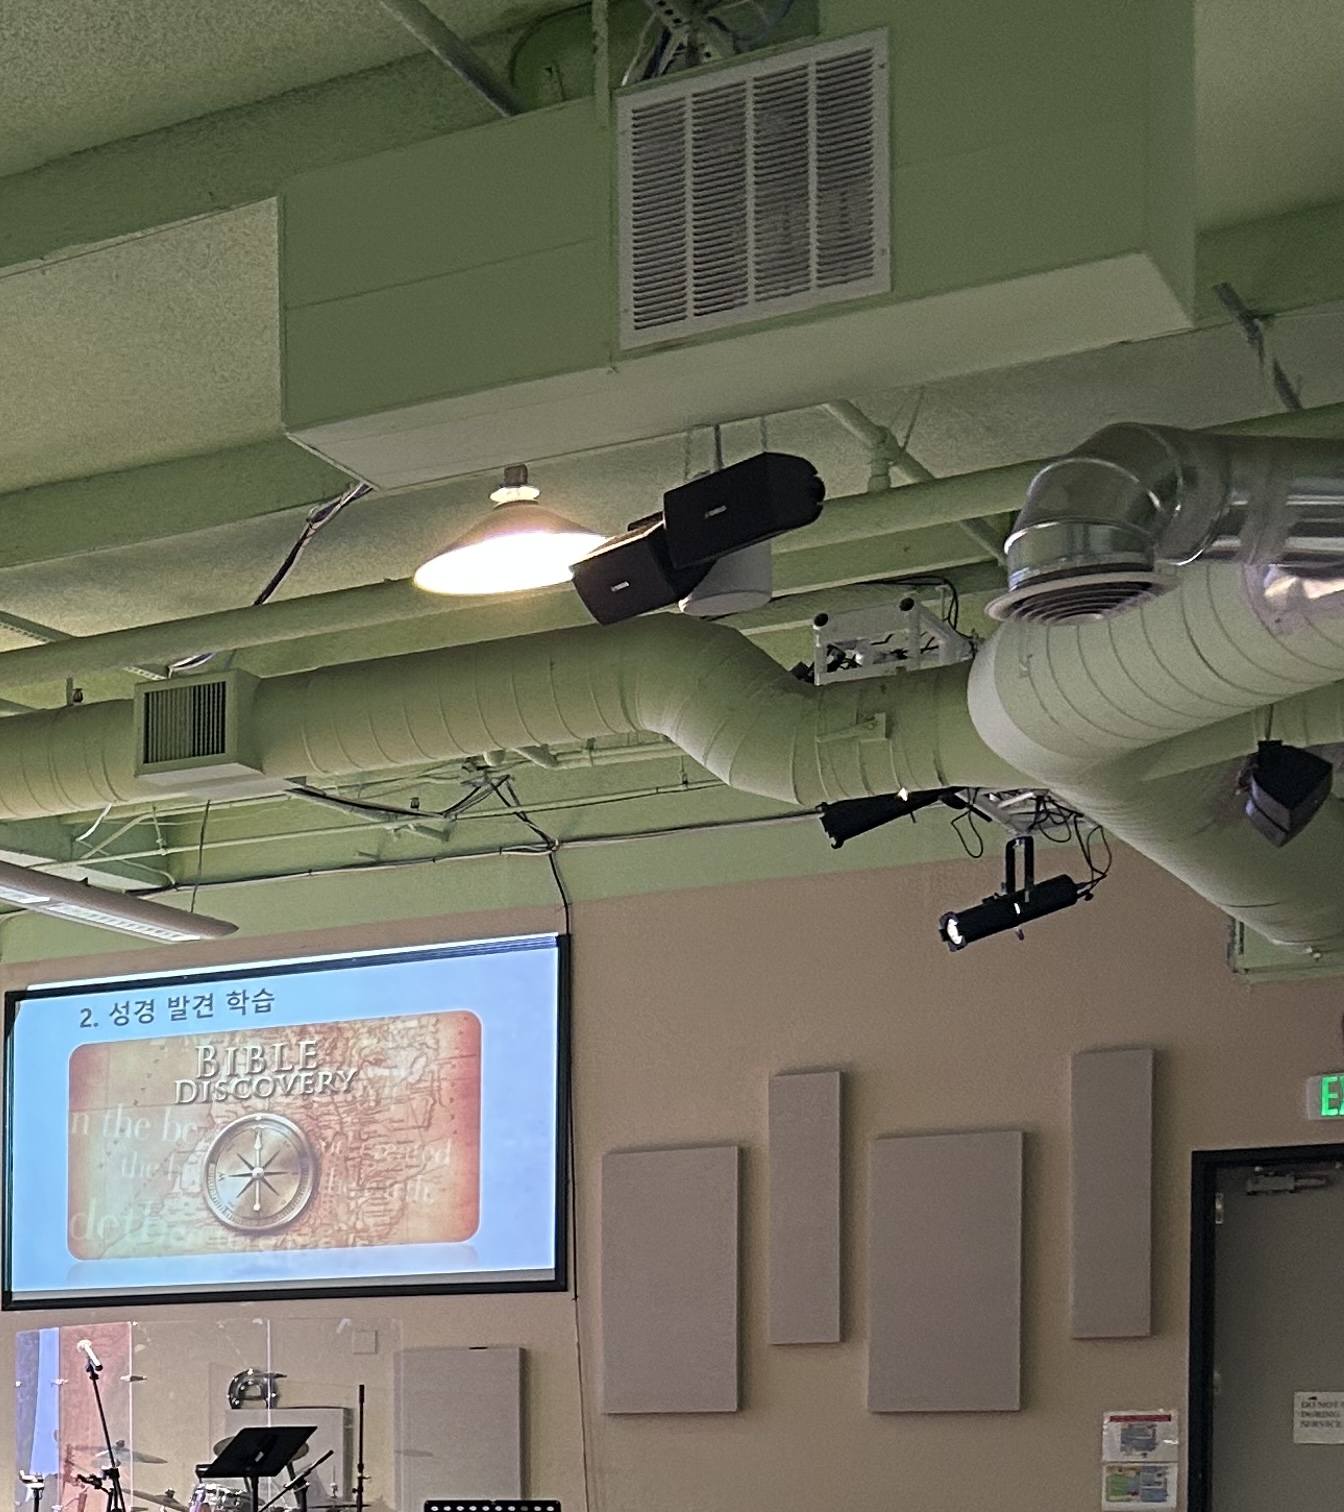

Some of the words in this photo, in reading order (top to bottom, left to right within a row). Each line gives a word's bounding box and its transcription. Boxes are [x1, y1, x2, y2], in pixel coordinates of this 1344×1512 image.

[79, 1007, 99, 1028] 2.
[109, 998, 156, 1026] 성경
[167, 992, 215, 1022] 발견
[226, 987, 276, 1016] 학습
[194, 1040, 319, 1081] BIBLE
[174, 1067, 359, 1105] DISCOVERY
[1321, 1075, 1344, 1116] E
